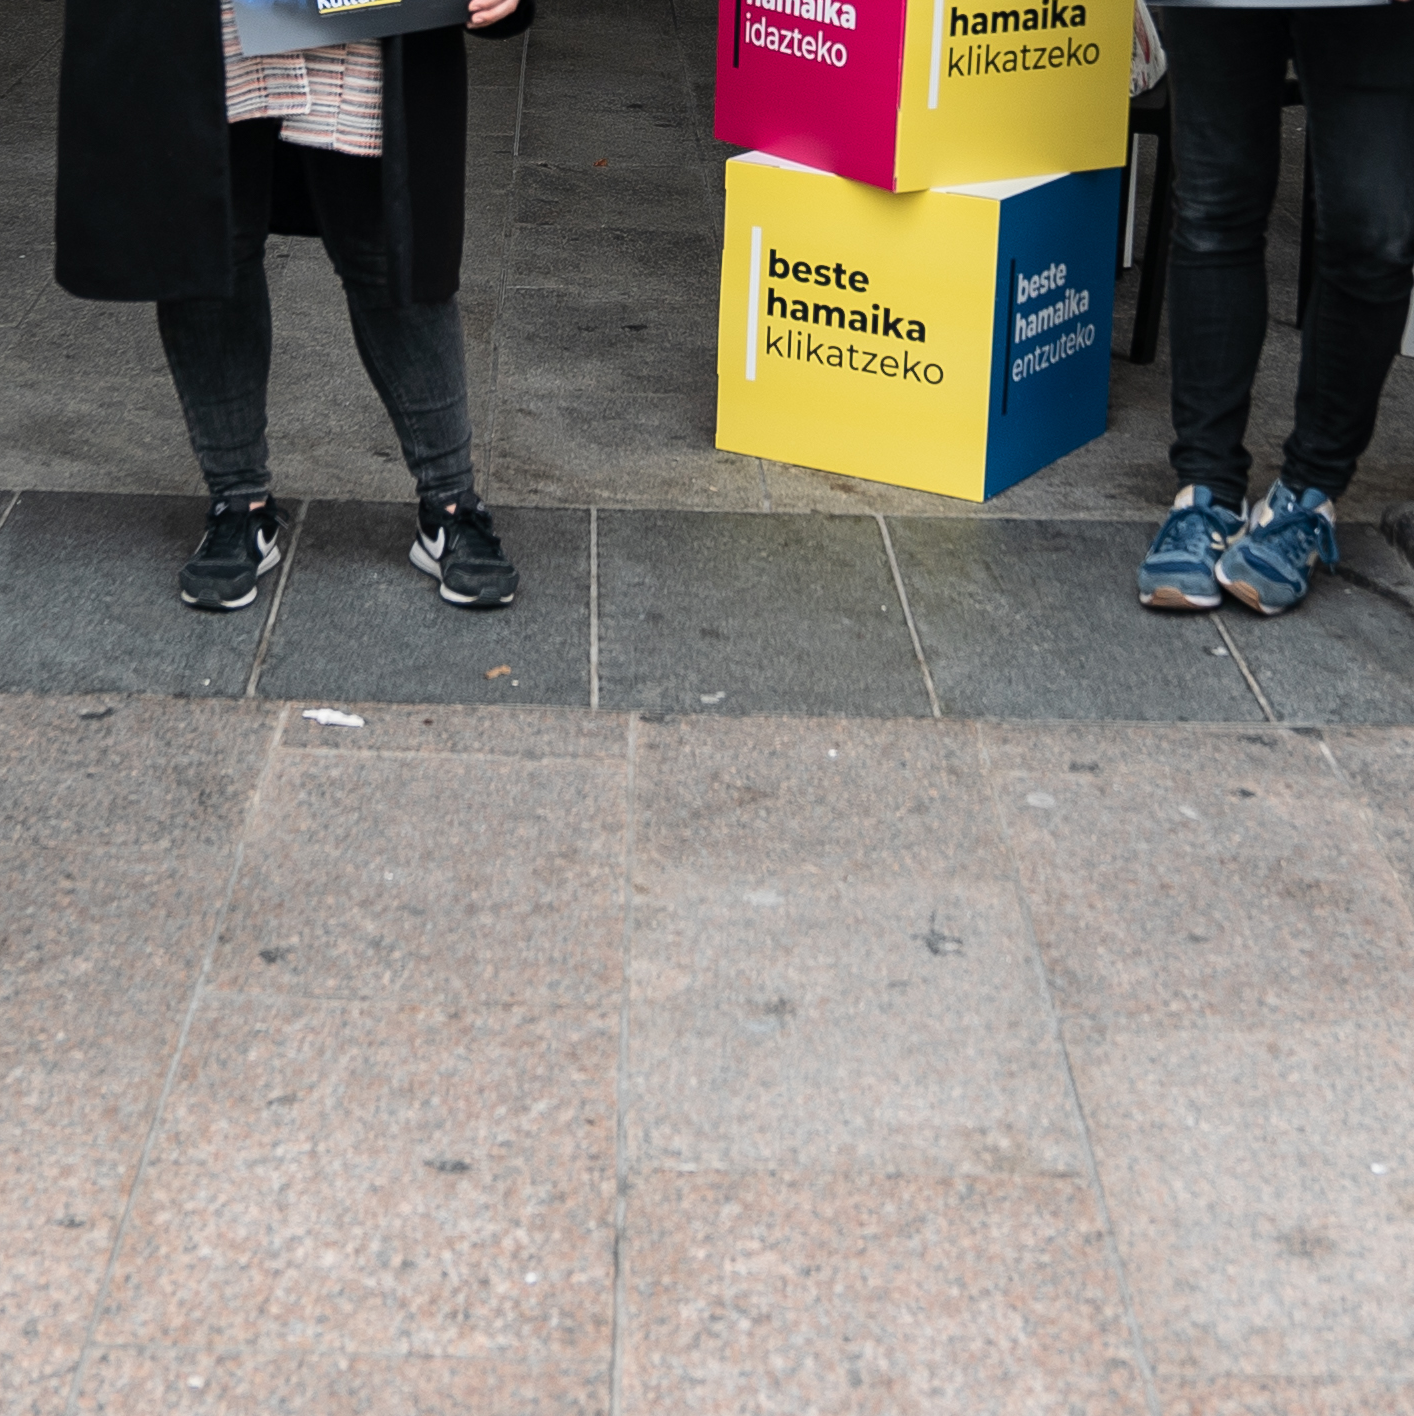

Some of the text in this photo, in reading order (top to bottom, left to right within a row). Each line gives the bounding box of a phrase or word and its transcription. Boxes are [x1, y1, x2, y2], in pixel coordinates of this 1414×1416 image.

[744, 13, 848, 68] idazteko
[947, 37, 1100, 78] klikatzeko
[768, 248, 870, 294] beste
[1017, 262, 1067, 305] beste
[767, 288, 927, 343] hamaika
[1014, 288, 1090, 344] hamaika
[765, 326, 944, 385] klikatzeko
[1012, 322, 1095, 383] entzuteko
